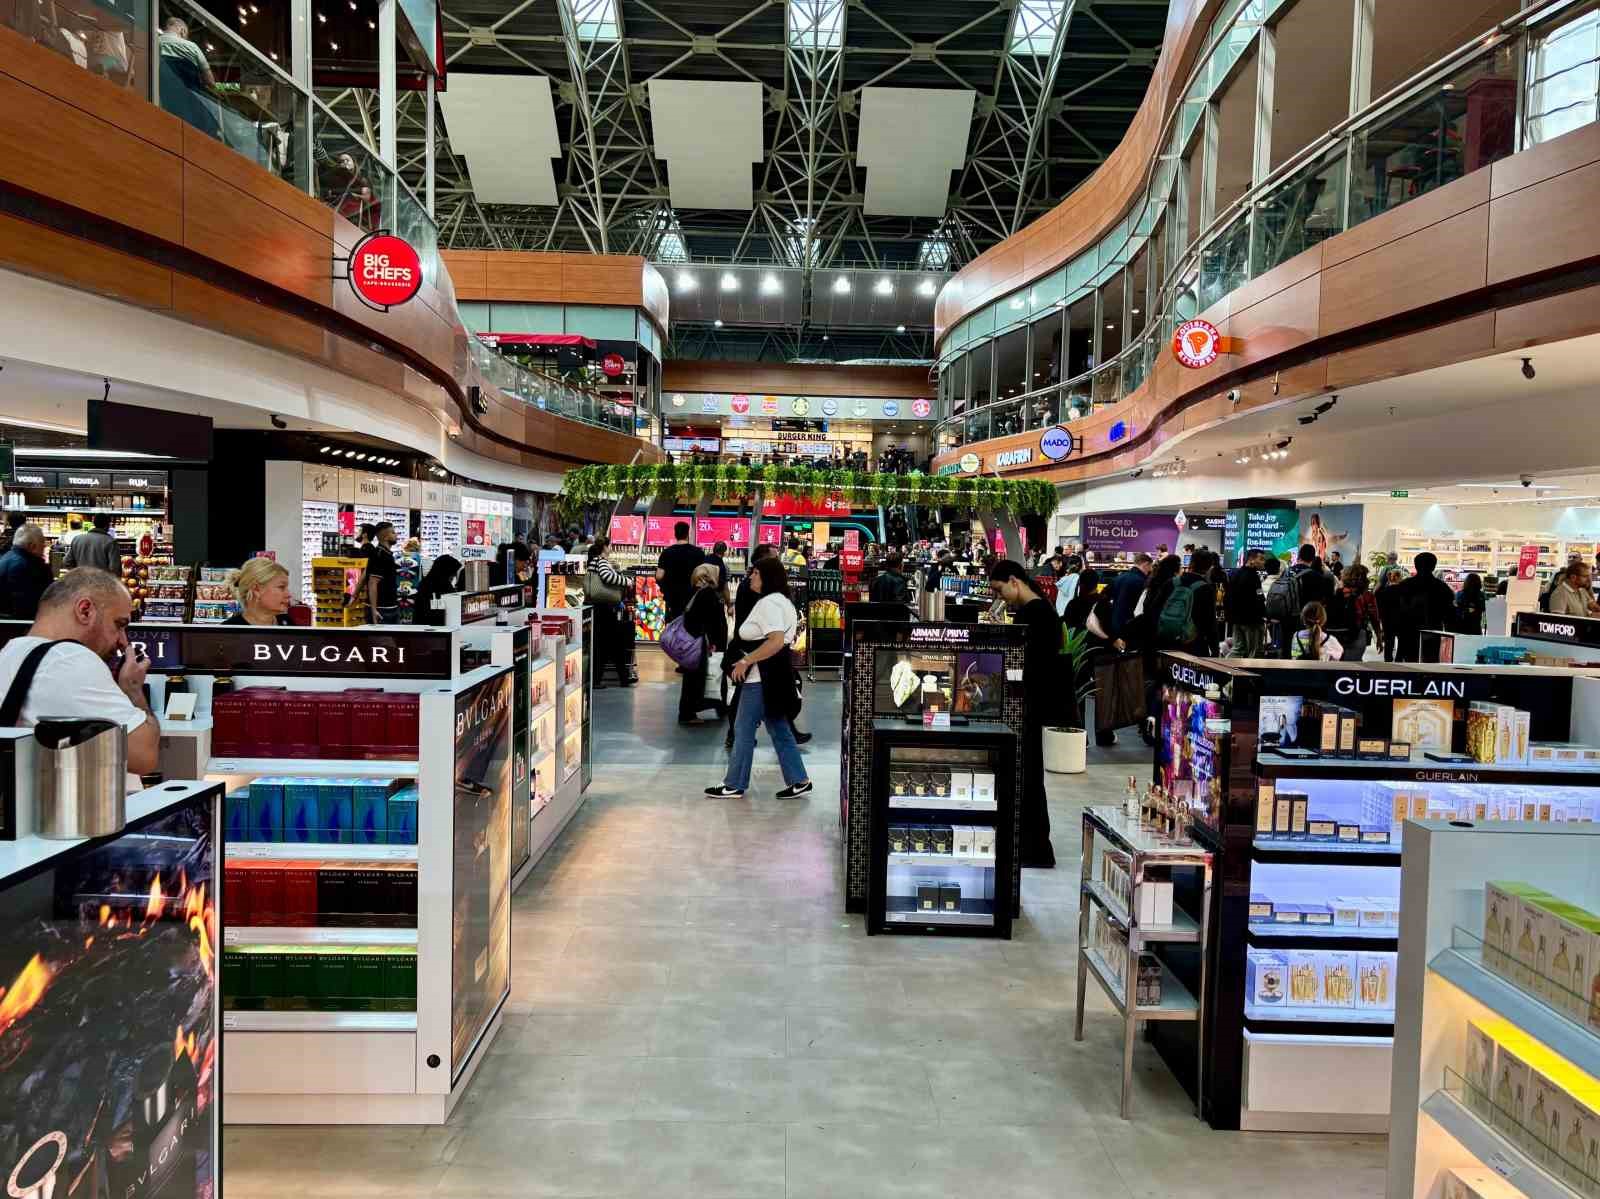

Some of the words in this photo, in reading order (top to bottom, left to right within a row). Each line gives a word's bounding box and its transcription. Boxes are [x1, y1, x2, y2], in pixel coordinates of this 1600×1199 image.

[363, 253, 390, 267] BIG
[362, 266, 412, 281] CHEFS
[777, 432, 805, 440] BURGER
[807, 432, 827, 440] KING
[1043, 439, 1069, 447] MADO
[128, 478, 148, 487] RUM
[1087, 517, 1123, 526] Welcome
[1087, 526, 1111, 537] The
[1111, 526, 1139, 538] Club
[1538, 622, 1555, 634] TOM
[1554, 623, 1576, 636] FORD
[253, 643, 405, 663] BVLGARI
[1171, 663, 1215, 690] GUERLAIN
[1335, 677, 1465, 698] GUERLAIN
[456, 687, 510, 737] BVLGARI
[1416, 771, 1479, 782] GUERLAIN
